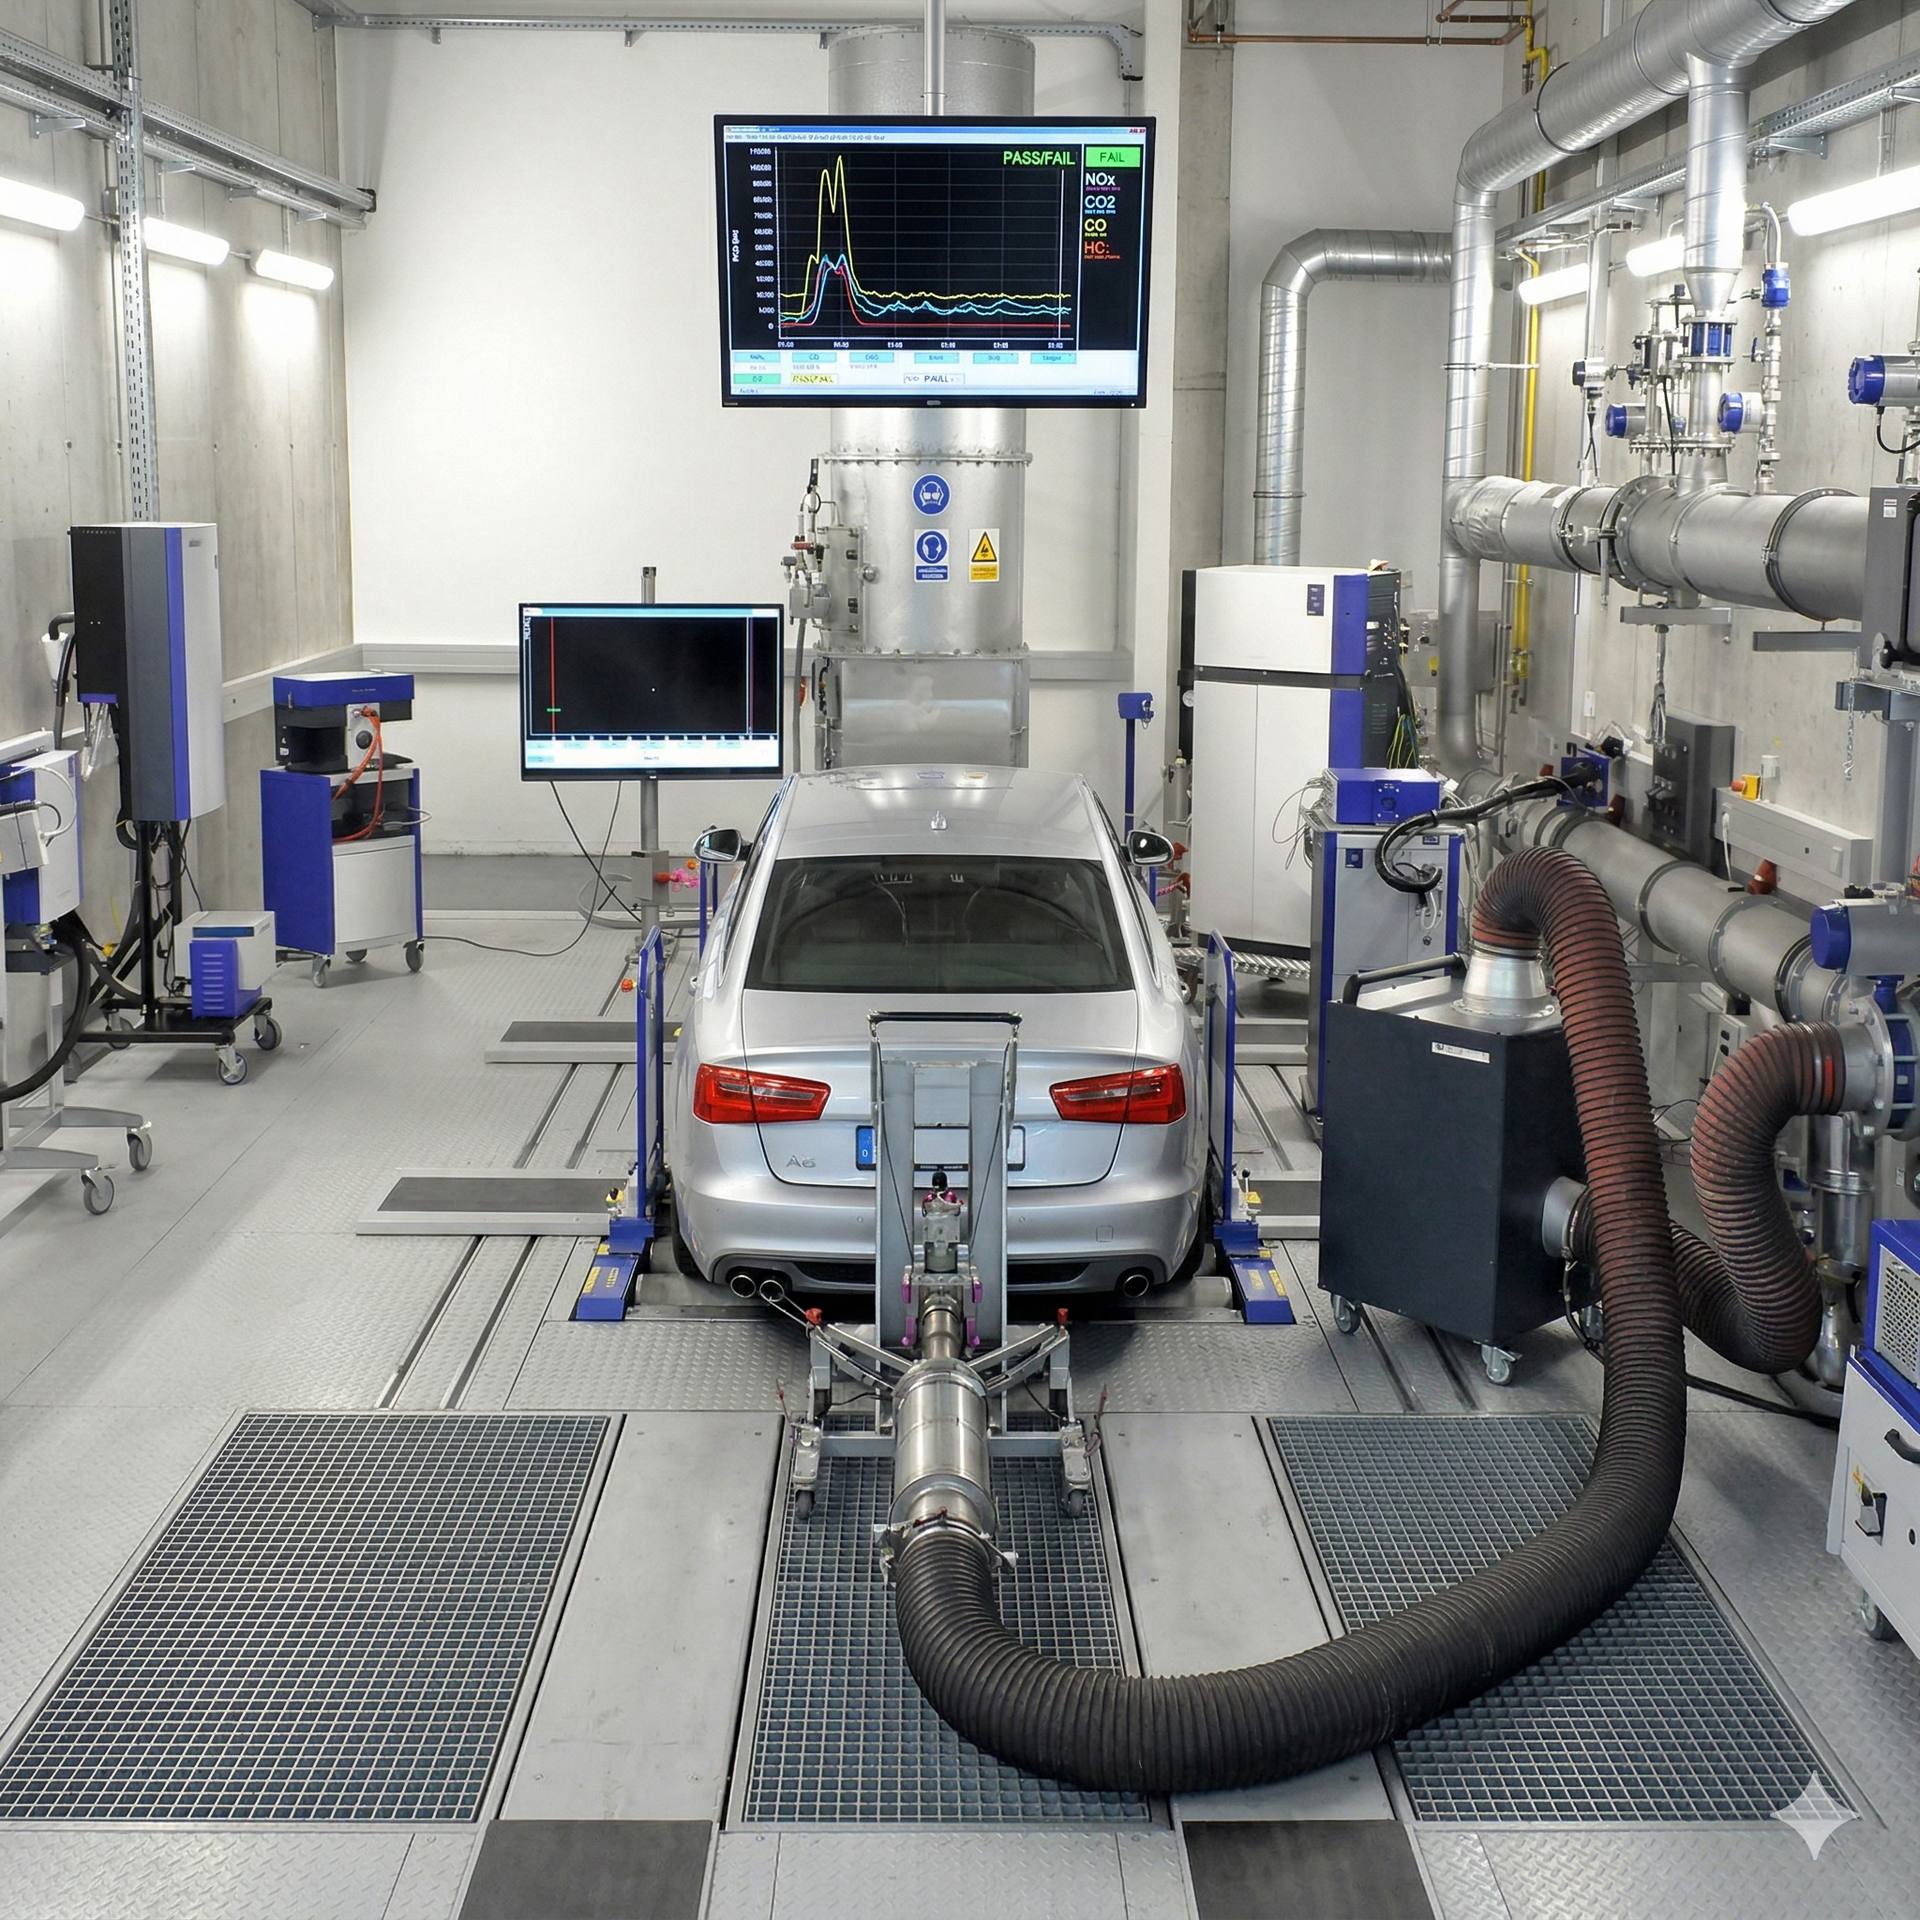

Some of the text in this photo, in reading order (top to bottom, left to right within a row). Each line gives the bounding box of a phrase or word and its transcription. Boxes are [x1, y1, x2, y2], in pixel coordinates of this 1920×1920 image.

[1003, 151, 1076, 166] PASS/FAIL
[1100, 152, 1125, 163] FAIL
[1085, 172, 1116, 186] NOx
[1084, 195, 1116, 209] CO2
[1084, 218, 1107, 232] CO
[1084, 241, 1110, 255] HC:
[786, 1154, 816, 1168] A6
